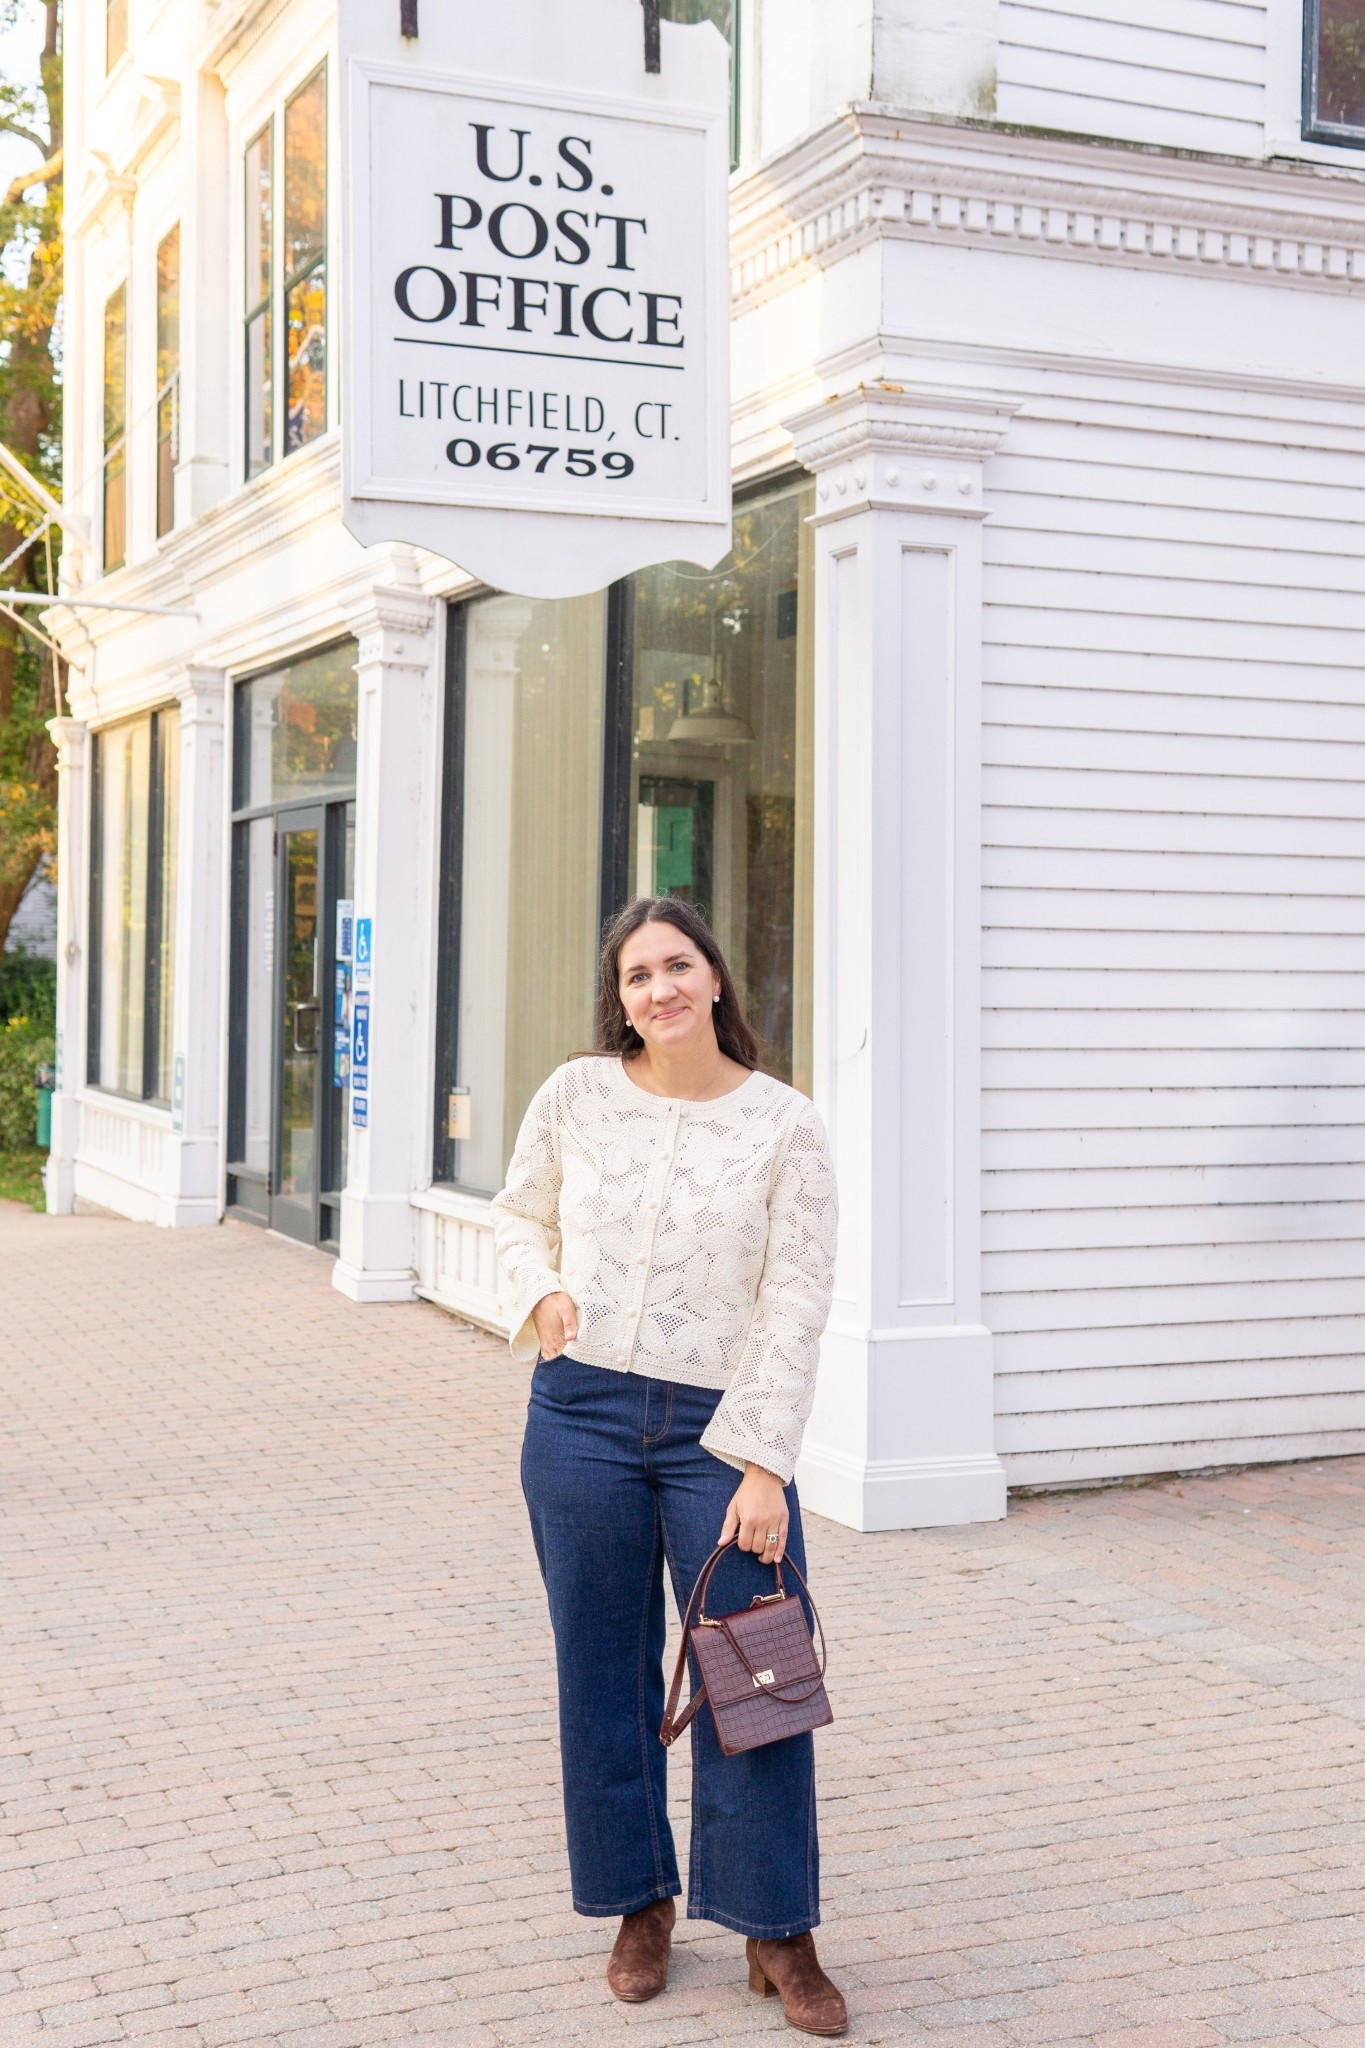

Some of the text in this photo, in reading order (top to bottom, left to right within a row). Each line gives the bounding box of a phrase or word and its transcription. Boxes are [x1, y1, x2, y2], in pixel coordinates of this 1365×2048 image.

[468, 122, 614, 196] U.S.
[433, 193, 647, 272] POST
[394, 265, 685, 349] OFFICE
[399, 379, 680, 442] LITCHFIELD, CT.
[445, 438, 635, 480] 06759
